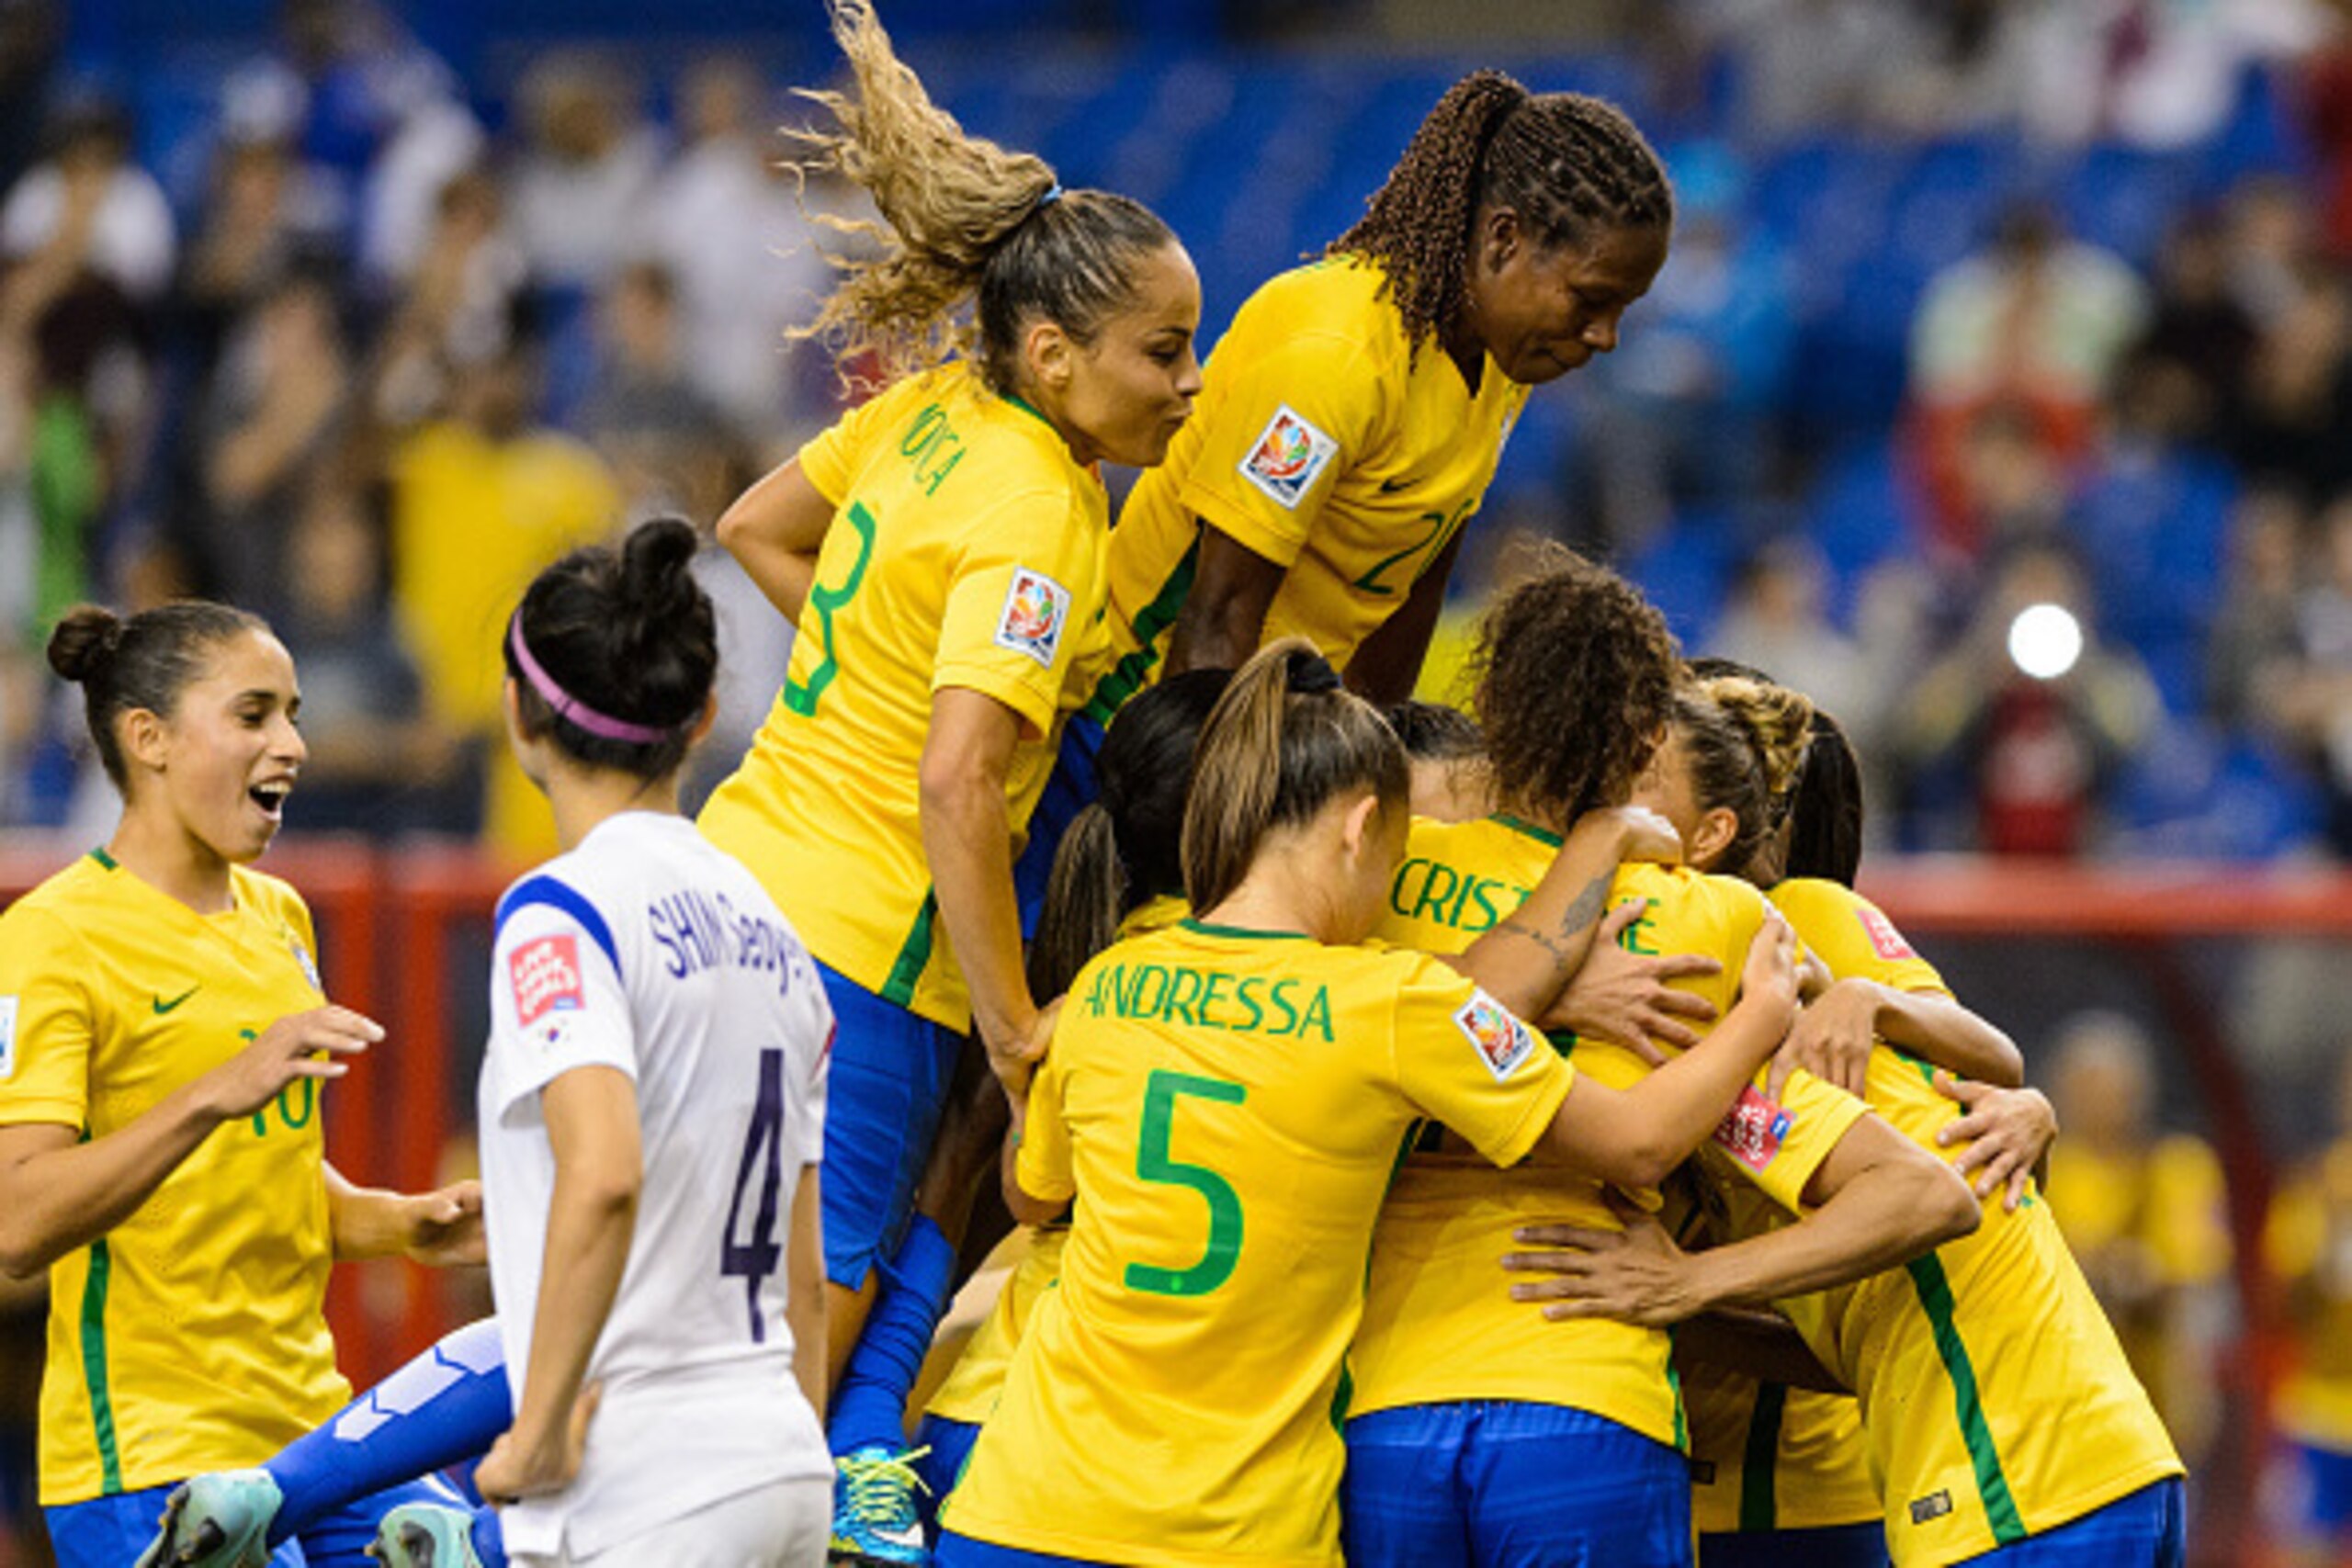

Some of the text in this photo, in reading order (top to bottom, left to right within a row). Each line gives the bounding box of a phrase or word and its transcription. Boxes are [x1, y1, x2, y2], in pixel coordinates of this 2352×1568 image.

[783, 501, 876, 717] 3
[1078, 962, 1336, 1043] ANDRESSA
[720, 1048, 784, 1344] 4
[1124, 1067, 1248, 1297] 5
